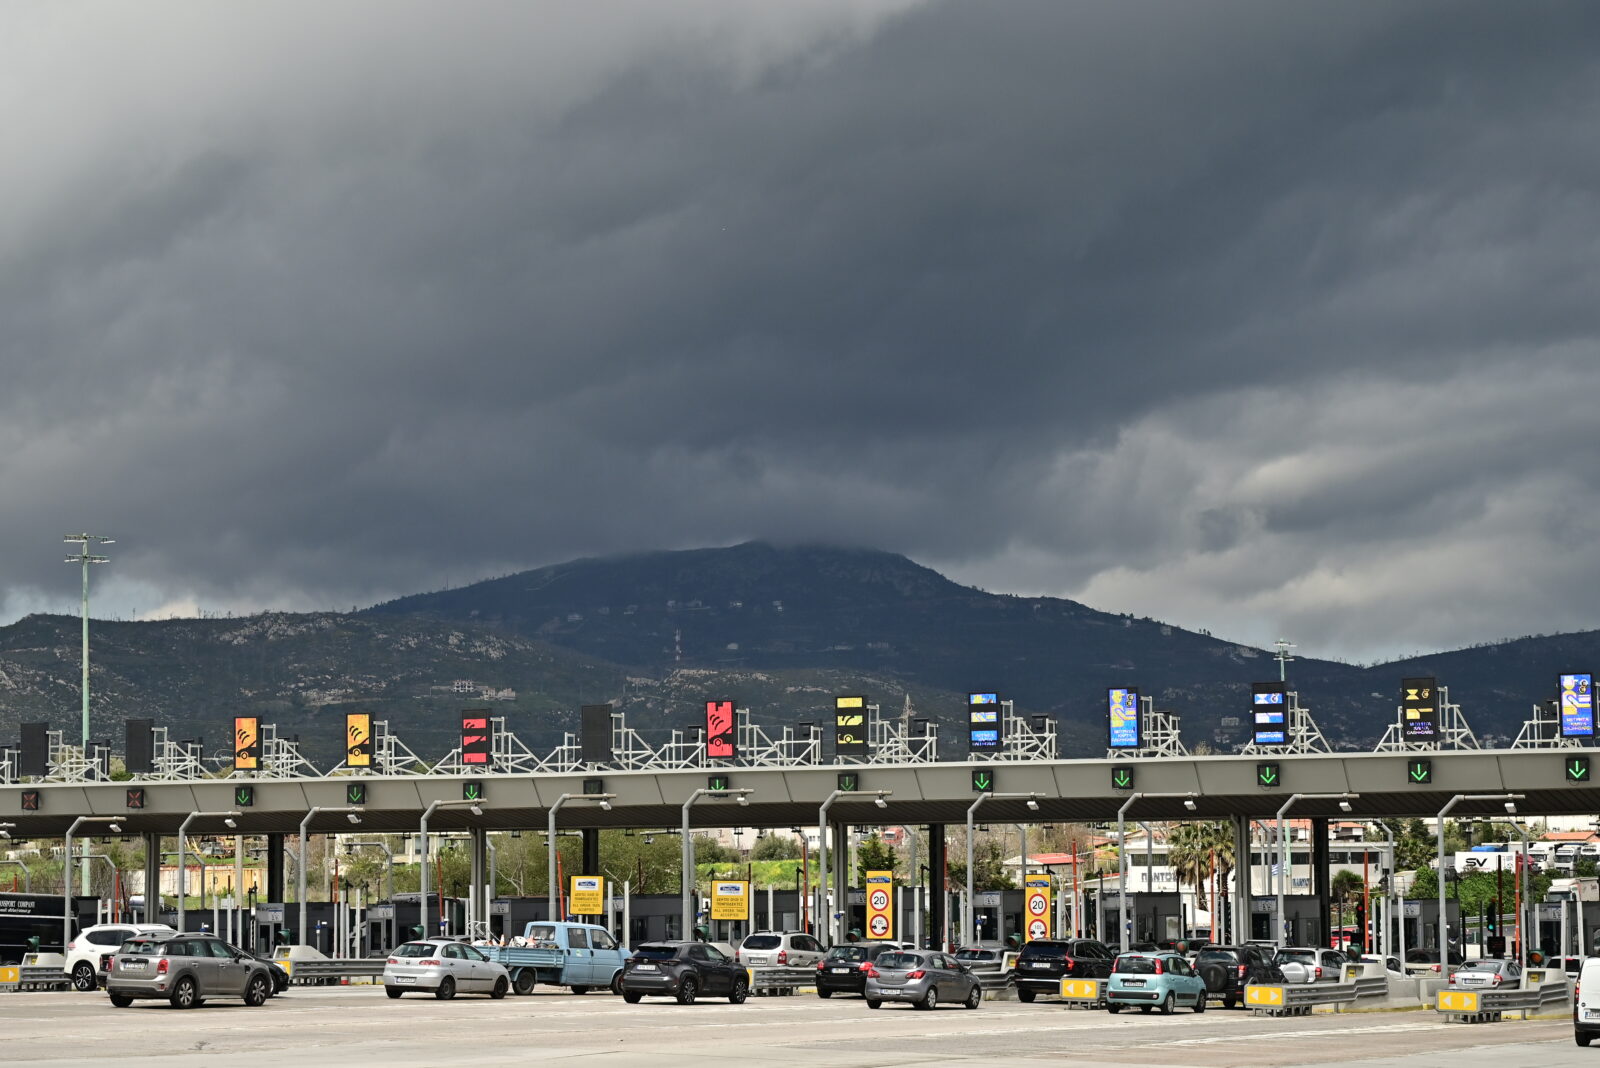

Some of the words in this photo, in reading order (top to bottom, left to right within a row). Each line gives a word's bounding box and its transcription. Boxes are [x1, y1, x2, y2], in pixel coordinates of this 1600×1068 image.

[1465, 857, 1488, 867] SV
[873, 895, 886, 905] 20
[1032, 900, 1044, 909] 20
